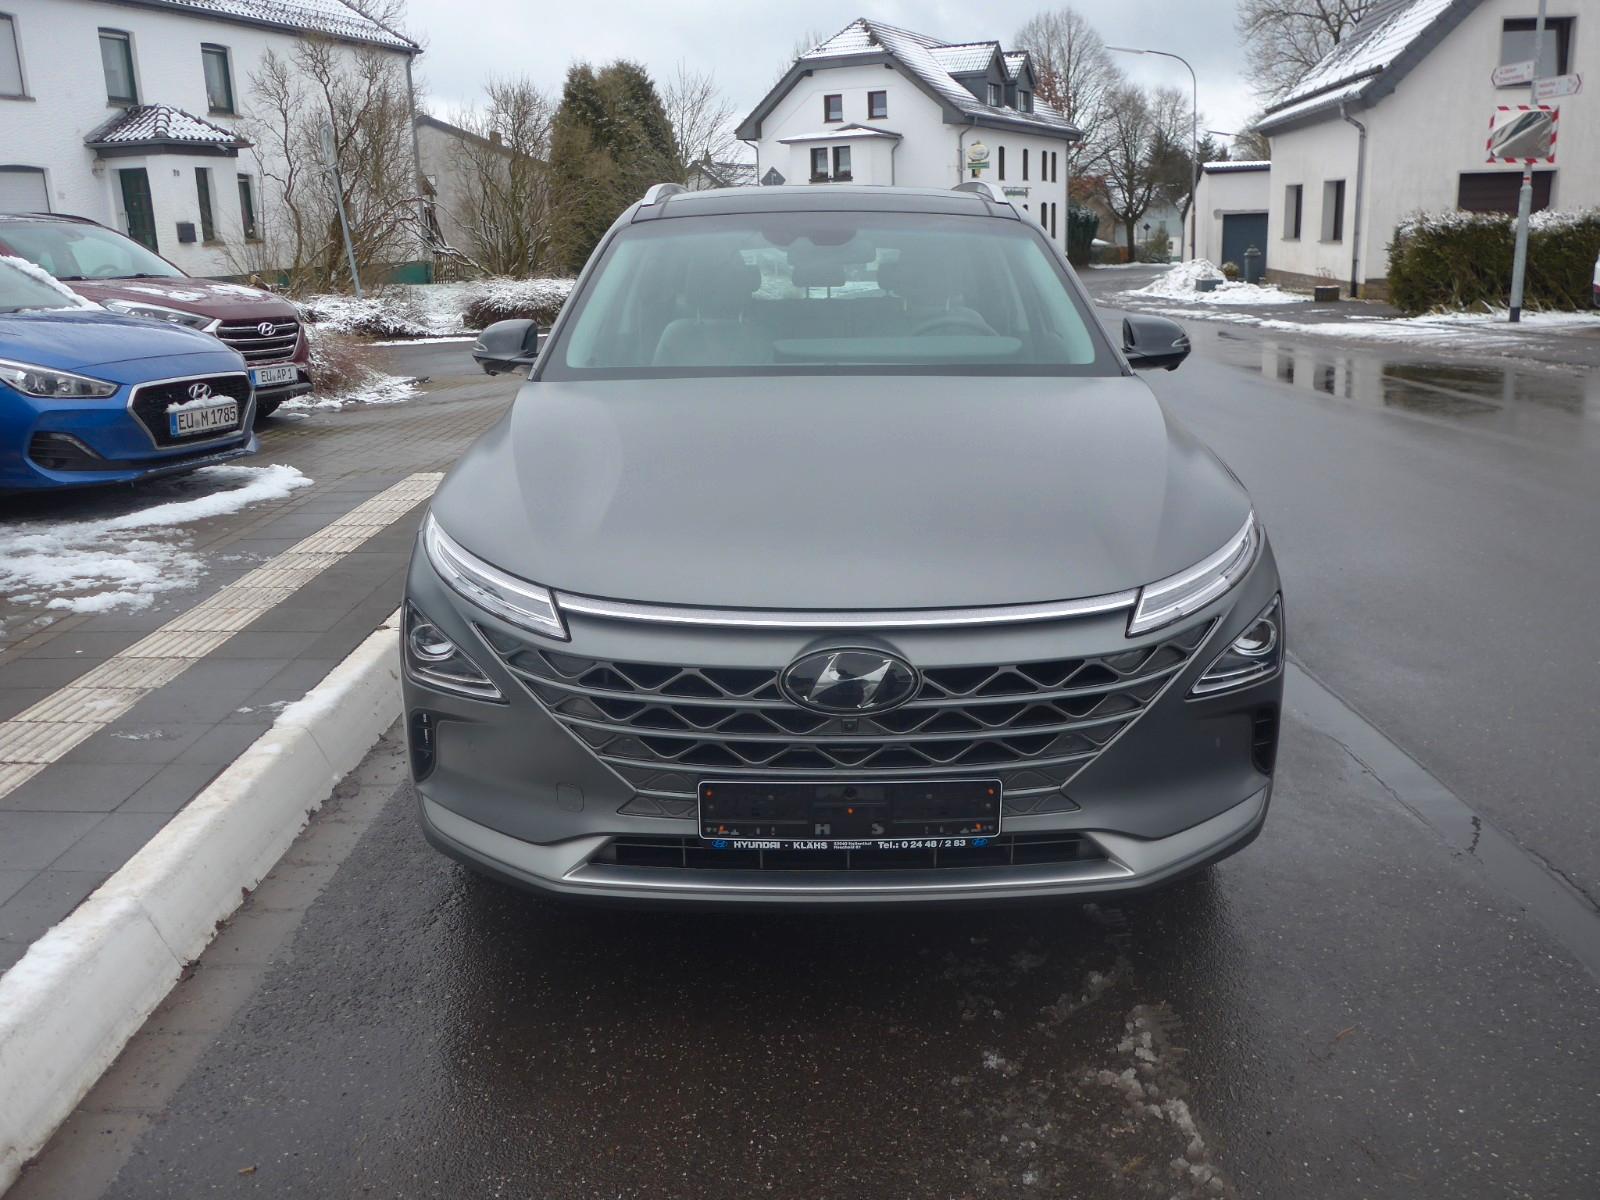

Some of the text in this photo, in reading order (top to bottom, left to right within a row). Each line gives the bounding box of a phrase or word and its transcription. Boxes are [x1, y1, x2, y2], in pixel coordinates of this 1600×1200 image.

[261, 370, 272, 382] EU
[277, 369, 287, 381] AP
[178, 413, 194, 430] EU
[733, 840, 781, 849] HYUNDAI
[793, 840, 828, 850] KLÄHS
[878, 841, 899, 849] Tel.:
[901, 841, 908, 849] 0
[910, 841, 923, 849] 24
[924, 840, 937, 848] 48
[953, 839, 966, 847] 83
